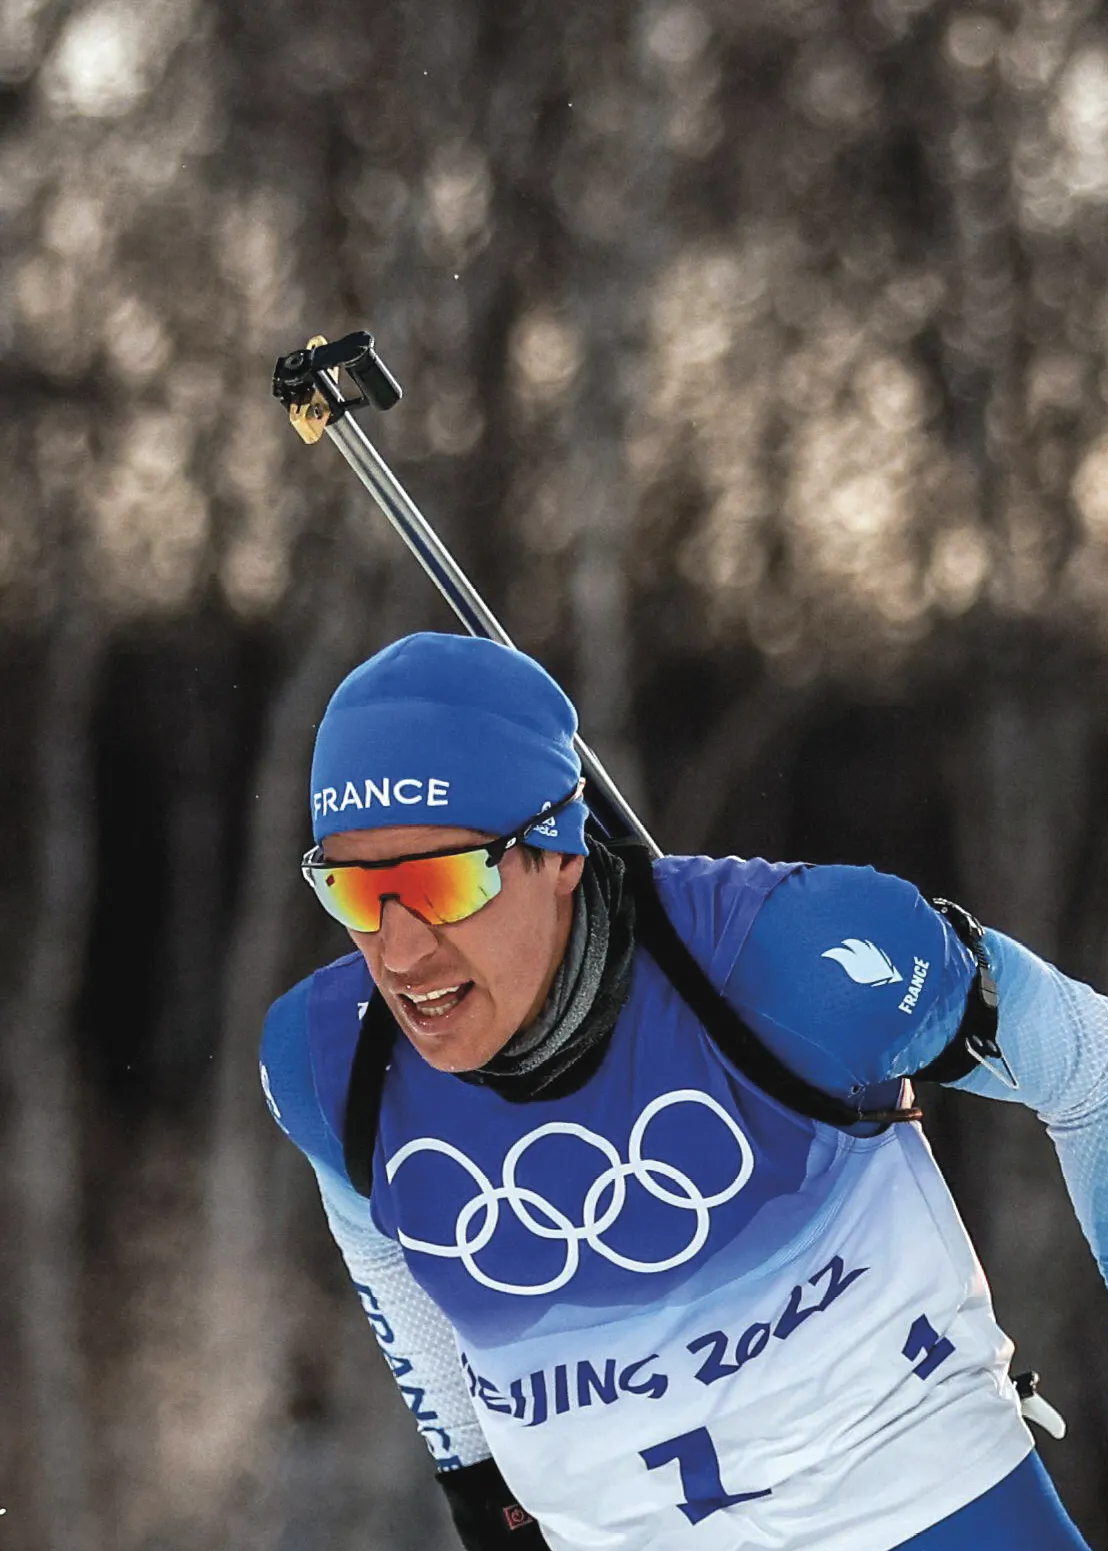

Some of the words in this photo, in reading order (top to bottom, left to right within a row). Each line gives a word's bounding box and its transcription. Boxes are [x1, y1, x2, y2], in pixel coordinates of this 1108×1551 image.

[312, 777, 450, 820] FRANCE
[898, 956, 930, 1014] FRANCE
[901, 1313, 956, 1381] 1
[639, 1425, 773, 1526] 1
